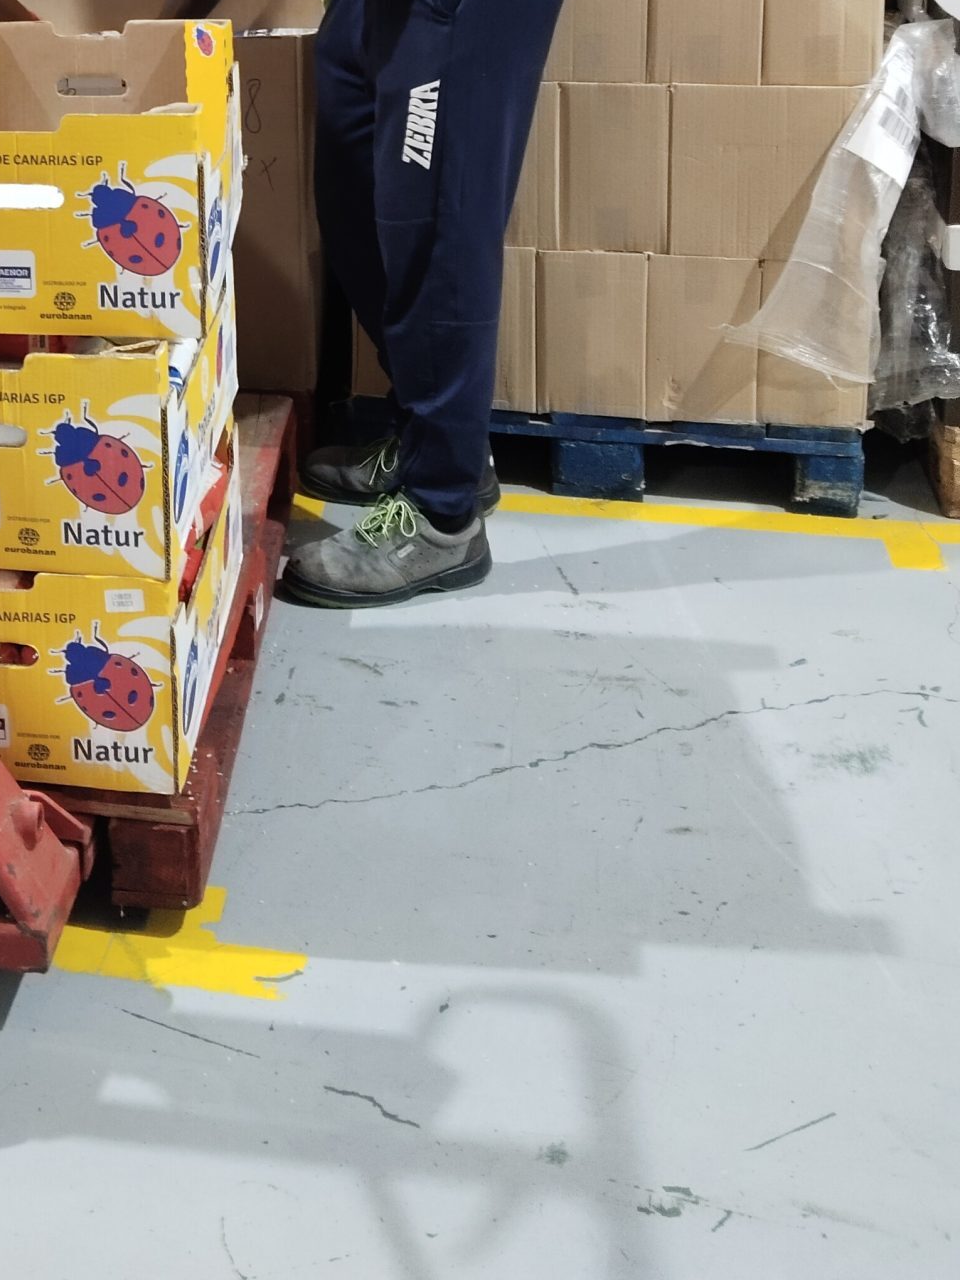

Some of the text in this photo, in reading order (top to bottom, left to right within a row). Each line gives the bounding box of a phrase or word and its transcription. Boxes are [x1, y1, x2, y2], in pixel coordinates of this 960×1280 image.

[402, 79, 441, 170] ZEBRA
[13, 154, 77, 167] CANARIAS
[81, 155, 103, 167] IGP
[99, 284, 181, 310] Natur
[39, 312, 92, 321] eurobanan
[44, 393, 66, 405] IGP
[63, 522, 145, 548] Natur
[4, 546, 57, 556] eurobanan
[54, 613, 76, 625] IGP
[73, 738, 154, 764] Natur
[14, 761, 67, 771] eurobanan
